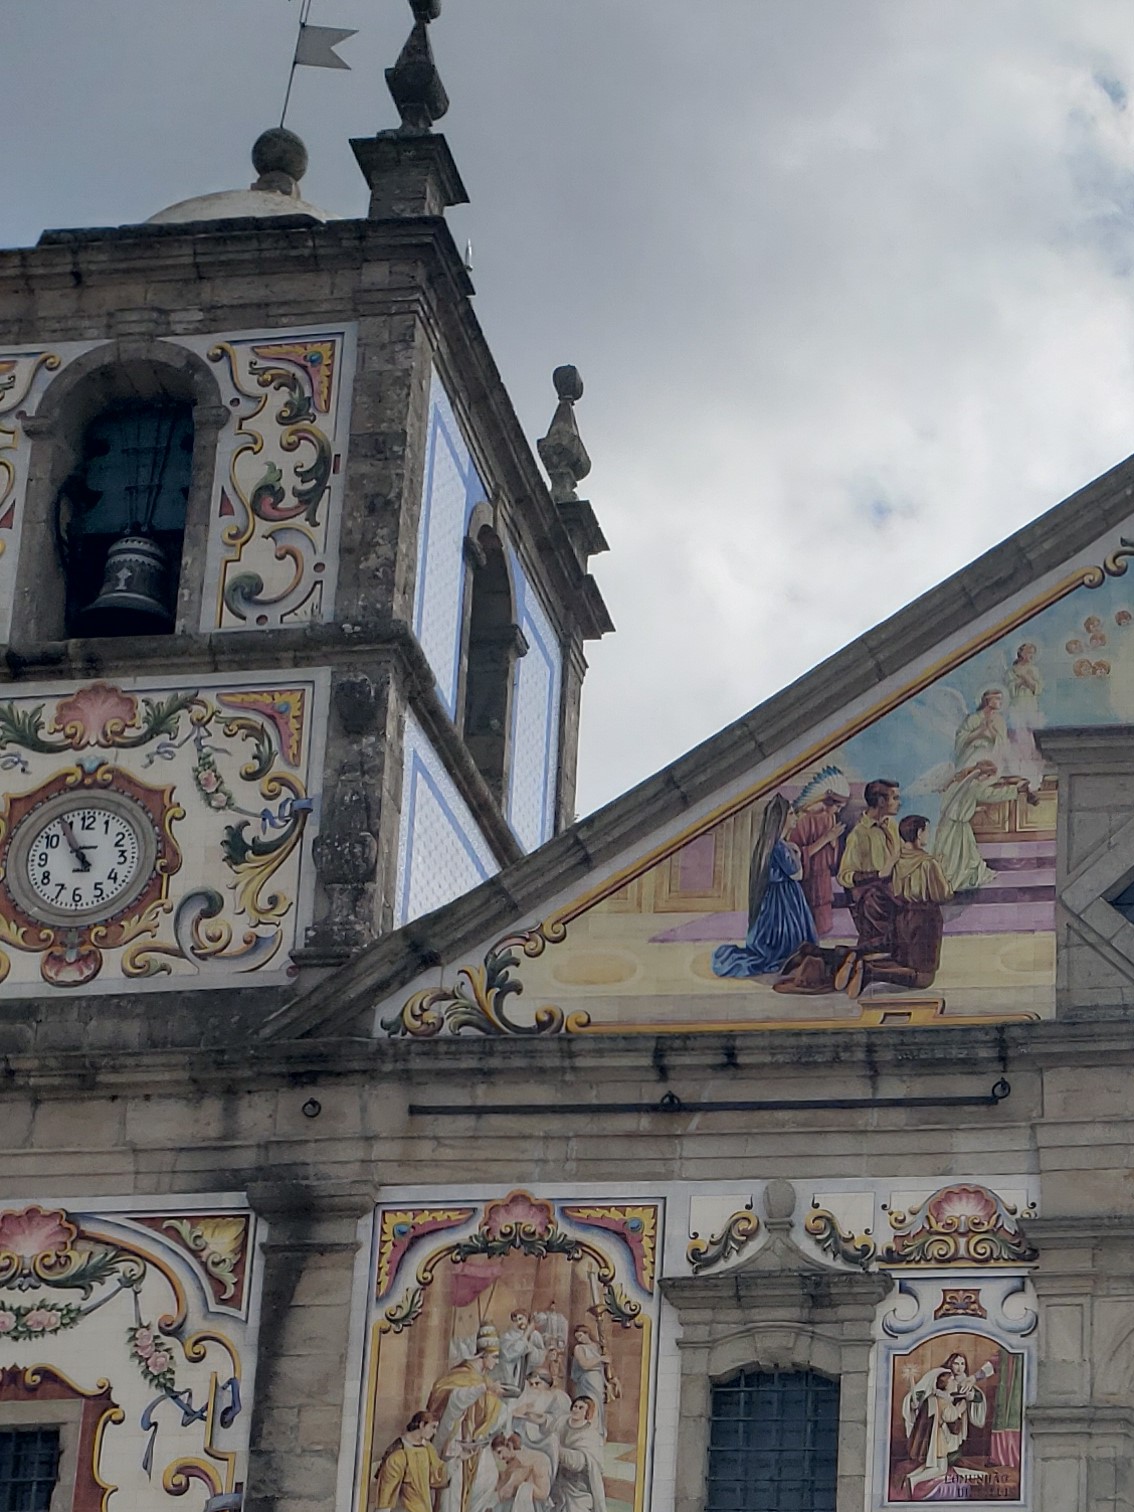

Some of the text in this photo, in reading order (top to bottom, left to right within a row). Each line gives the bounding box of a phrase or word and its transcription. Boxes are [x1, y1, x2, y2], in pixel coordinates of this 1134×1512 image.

[81, 815, 96, 831] 12
[104, 819, 110, 835] 1
[45, 834, 60, 849] 10
[114, 832, 126, 848] 2
[37, 852, 48, 868] 9
[117, 849, 128, 865] 3
[41, 870, 51, 886] 8
[107, 868, 118, 885] 4
[55, 883, 66, 899] 7
[72, 887, 82, 903] 6
[93, 882, 104, 898] 5
